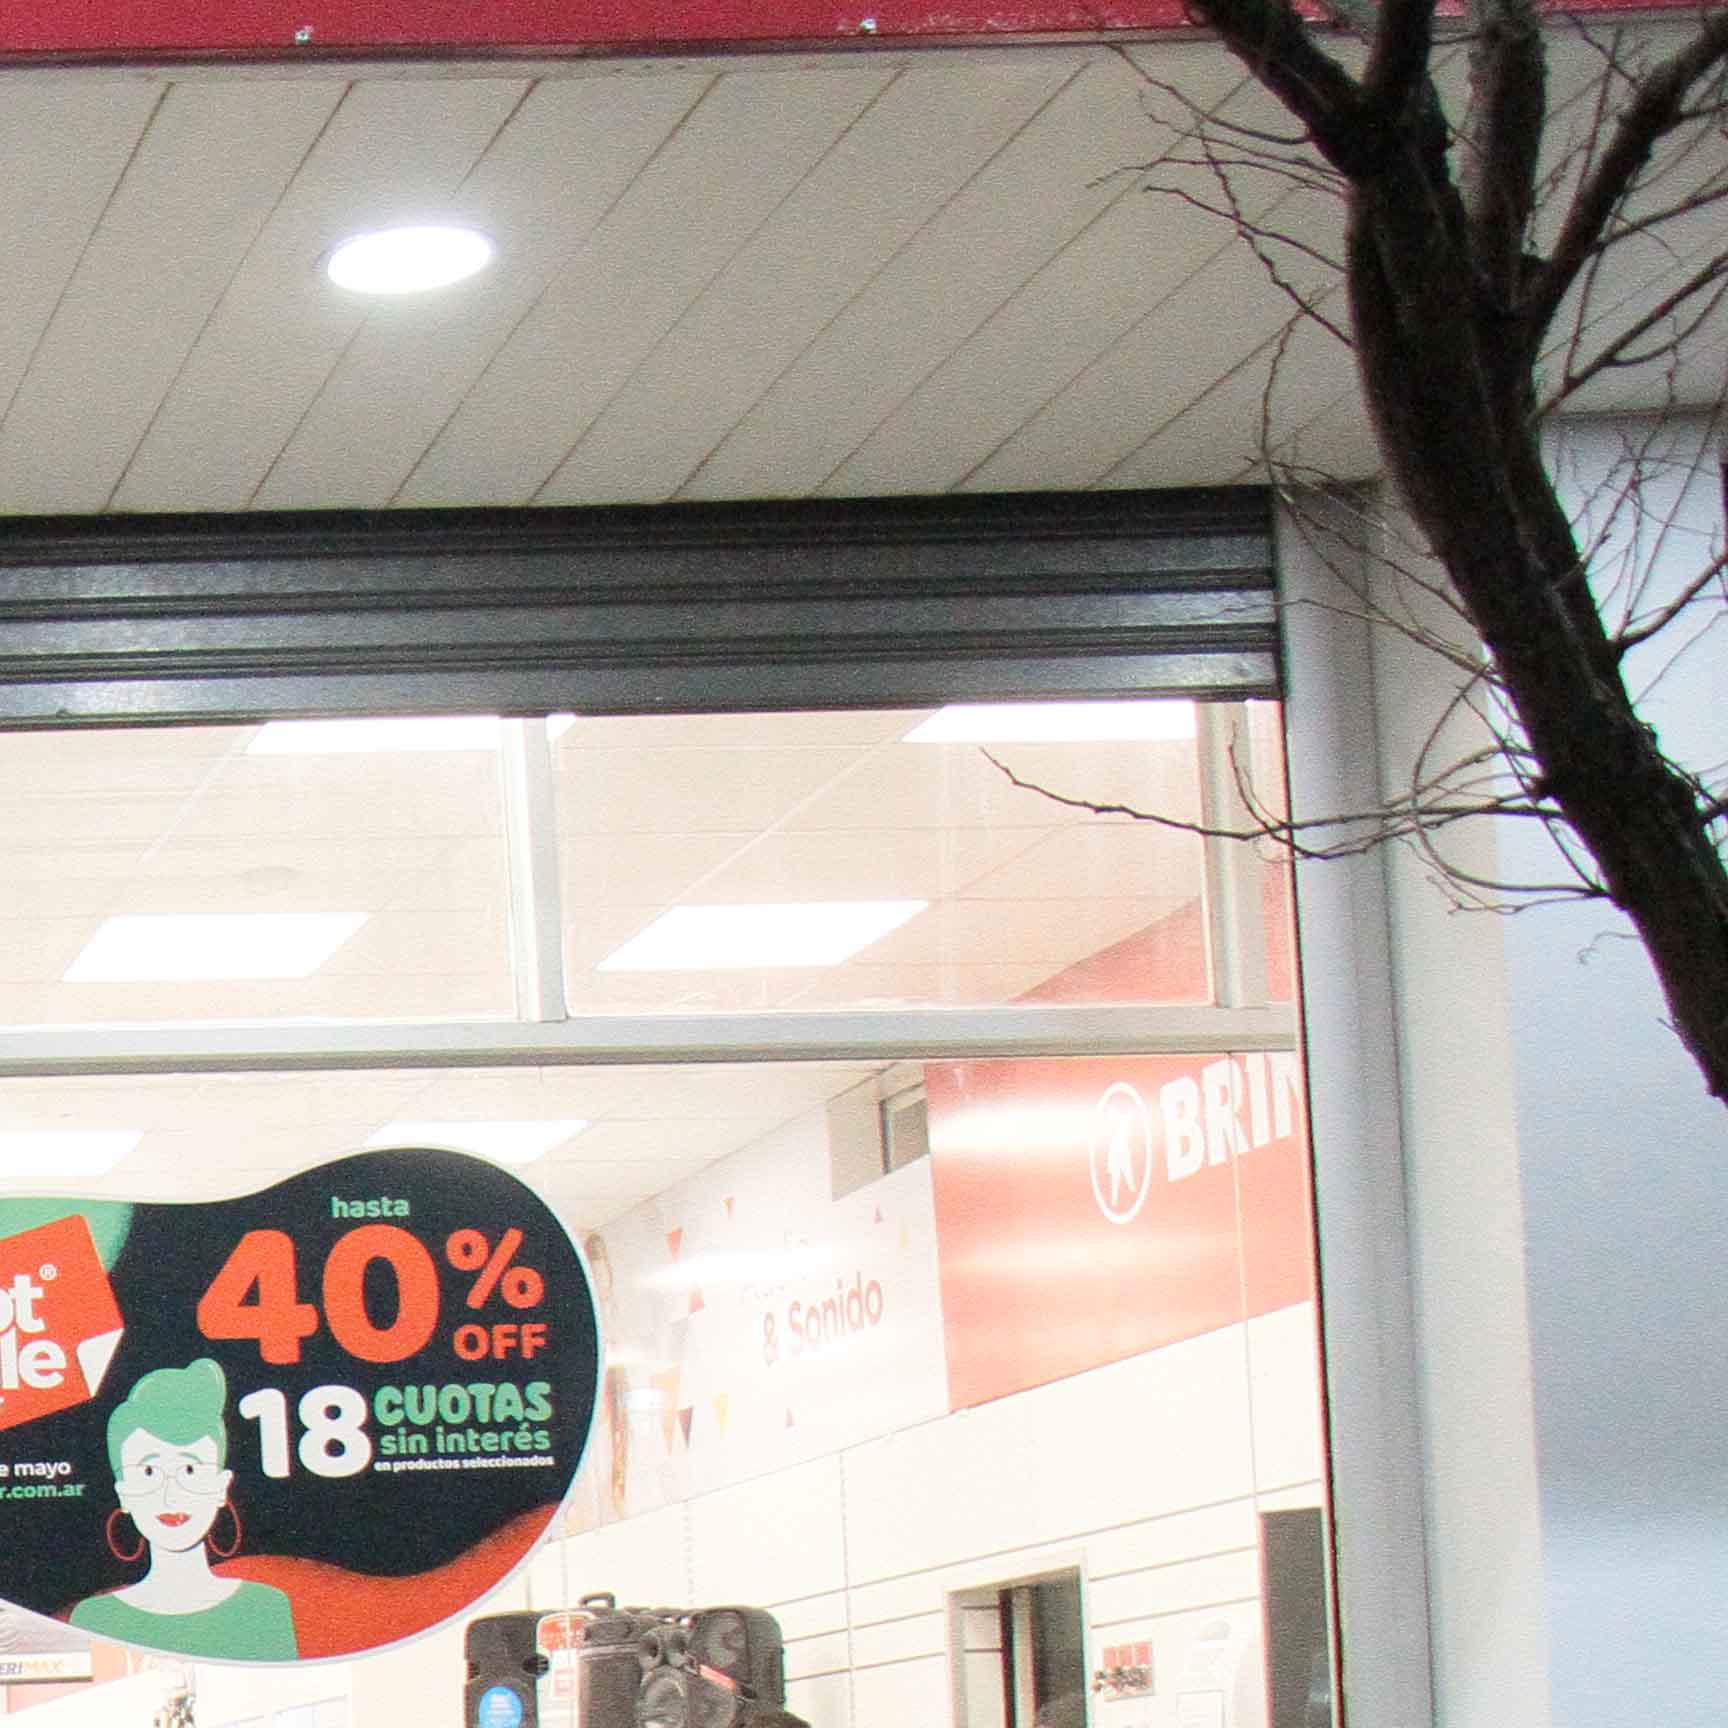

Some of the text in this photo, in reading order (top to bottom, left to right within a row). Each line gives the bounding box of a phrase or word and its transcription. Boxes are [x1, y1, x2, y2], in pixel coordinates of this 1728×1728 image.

[331, 1195, 411, 1219] hasta
[787, 1269, 885, 1357] Sonido
[452, 1323, 548, 1362] OFF
[238, 1380, 553, 1480] 18 CUOTAS
[380, 1421, 552, 1456] sin interés
[13, 1459, 73, 1485] mayo
[373, 1454, 556, 1473] en productos seleccionados
